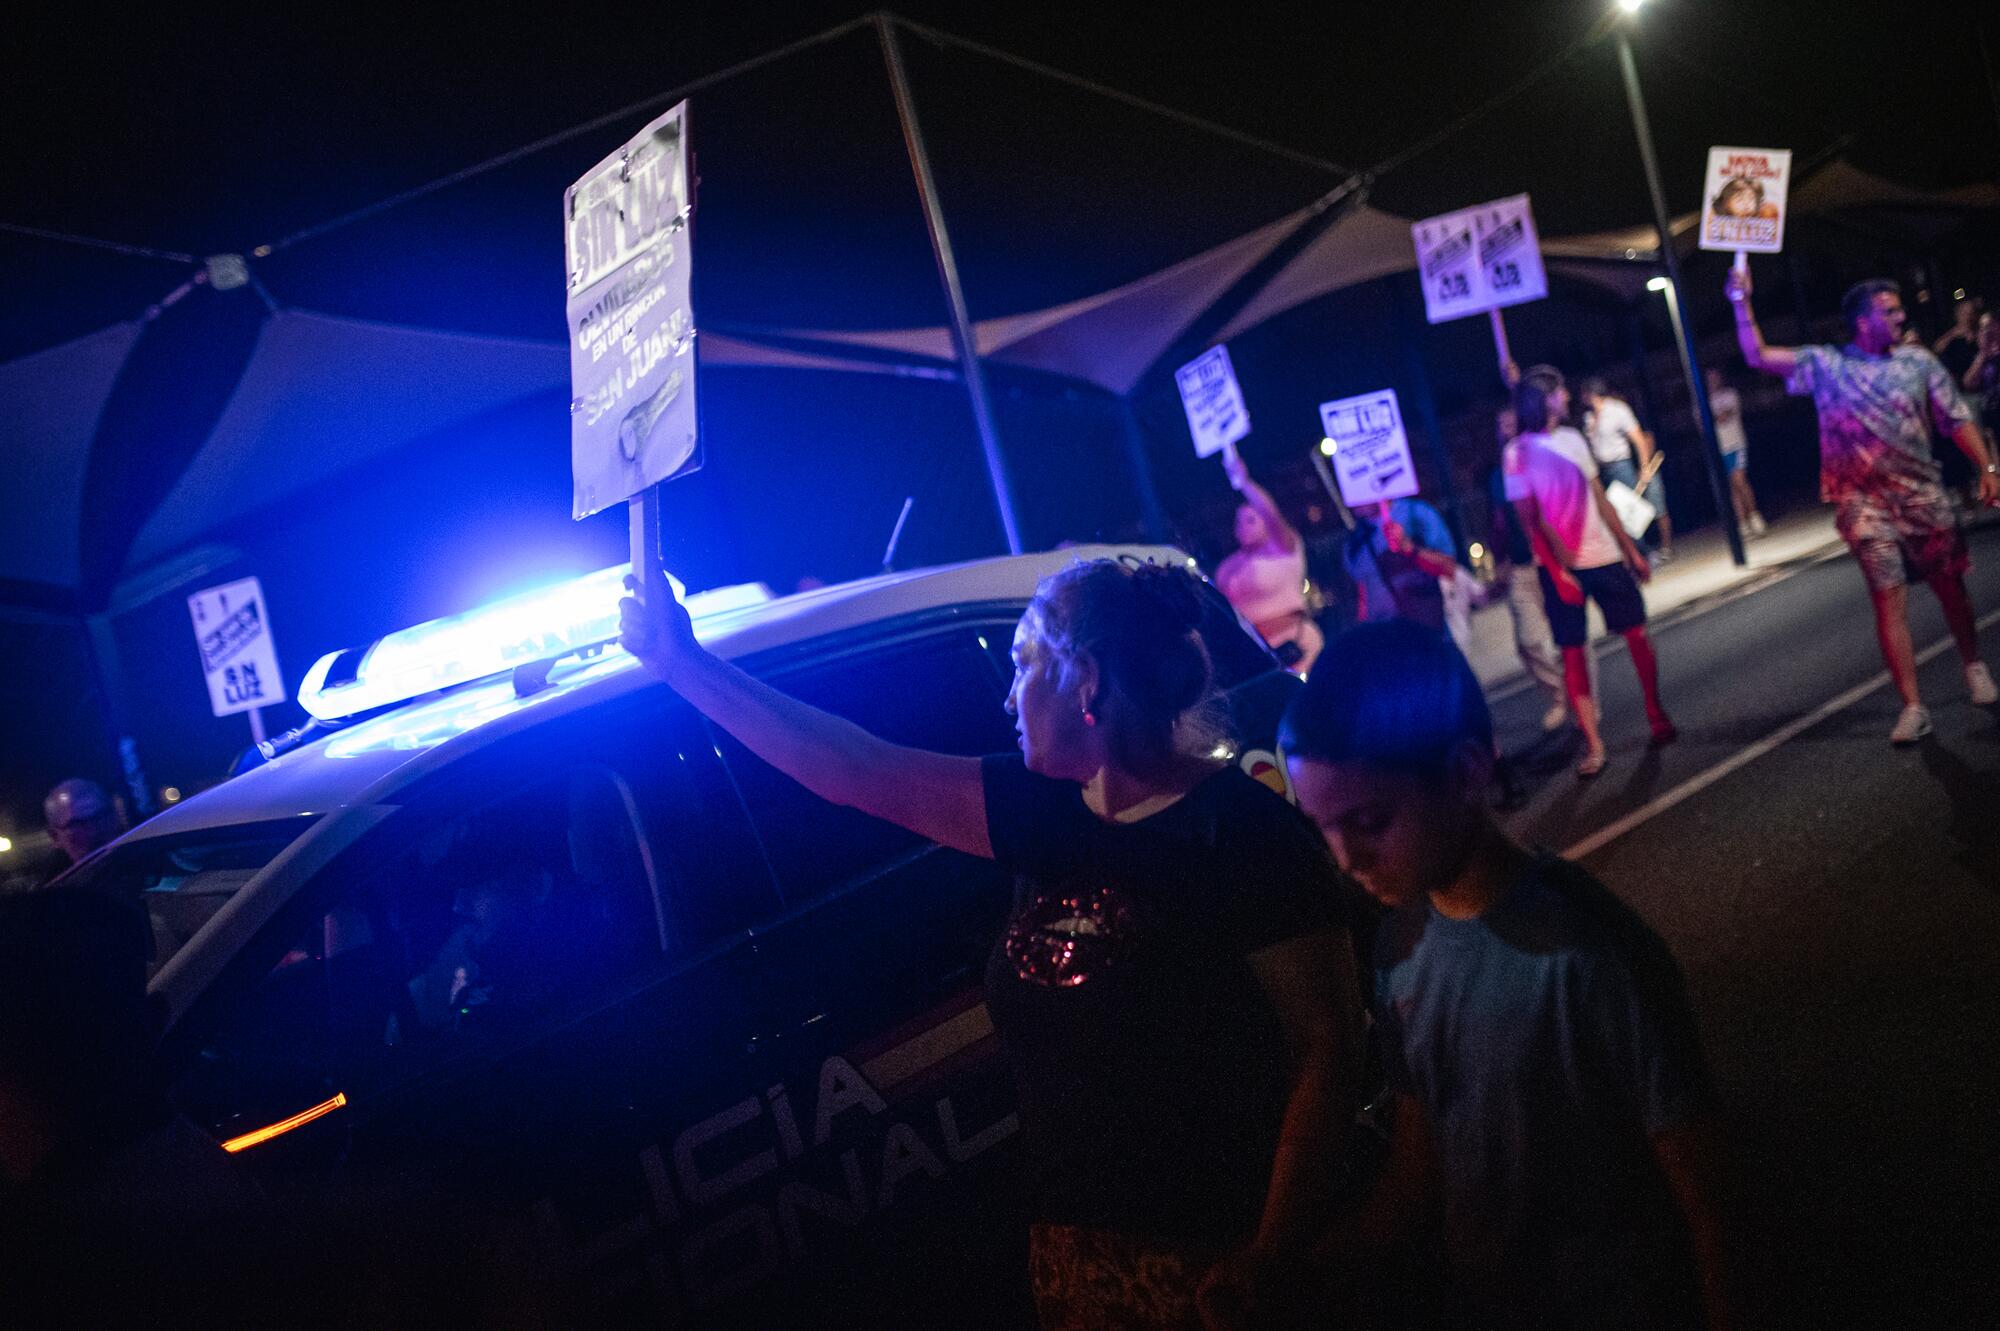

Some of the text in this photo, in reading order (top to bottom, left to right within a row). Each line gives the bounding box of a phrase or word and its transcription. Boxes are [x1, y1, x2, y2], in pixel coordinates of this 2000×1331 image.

[592, 338, 608, 363] EN
[607, 317, 625, 347] UN
[622, 330, 638, 355] DE
[587, 366, 623, 427] SAN
